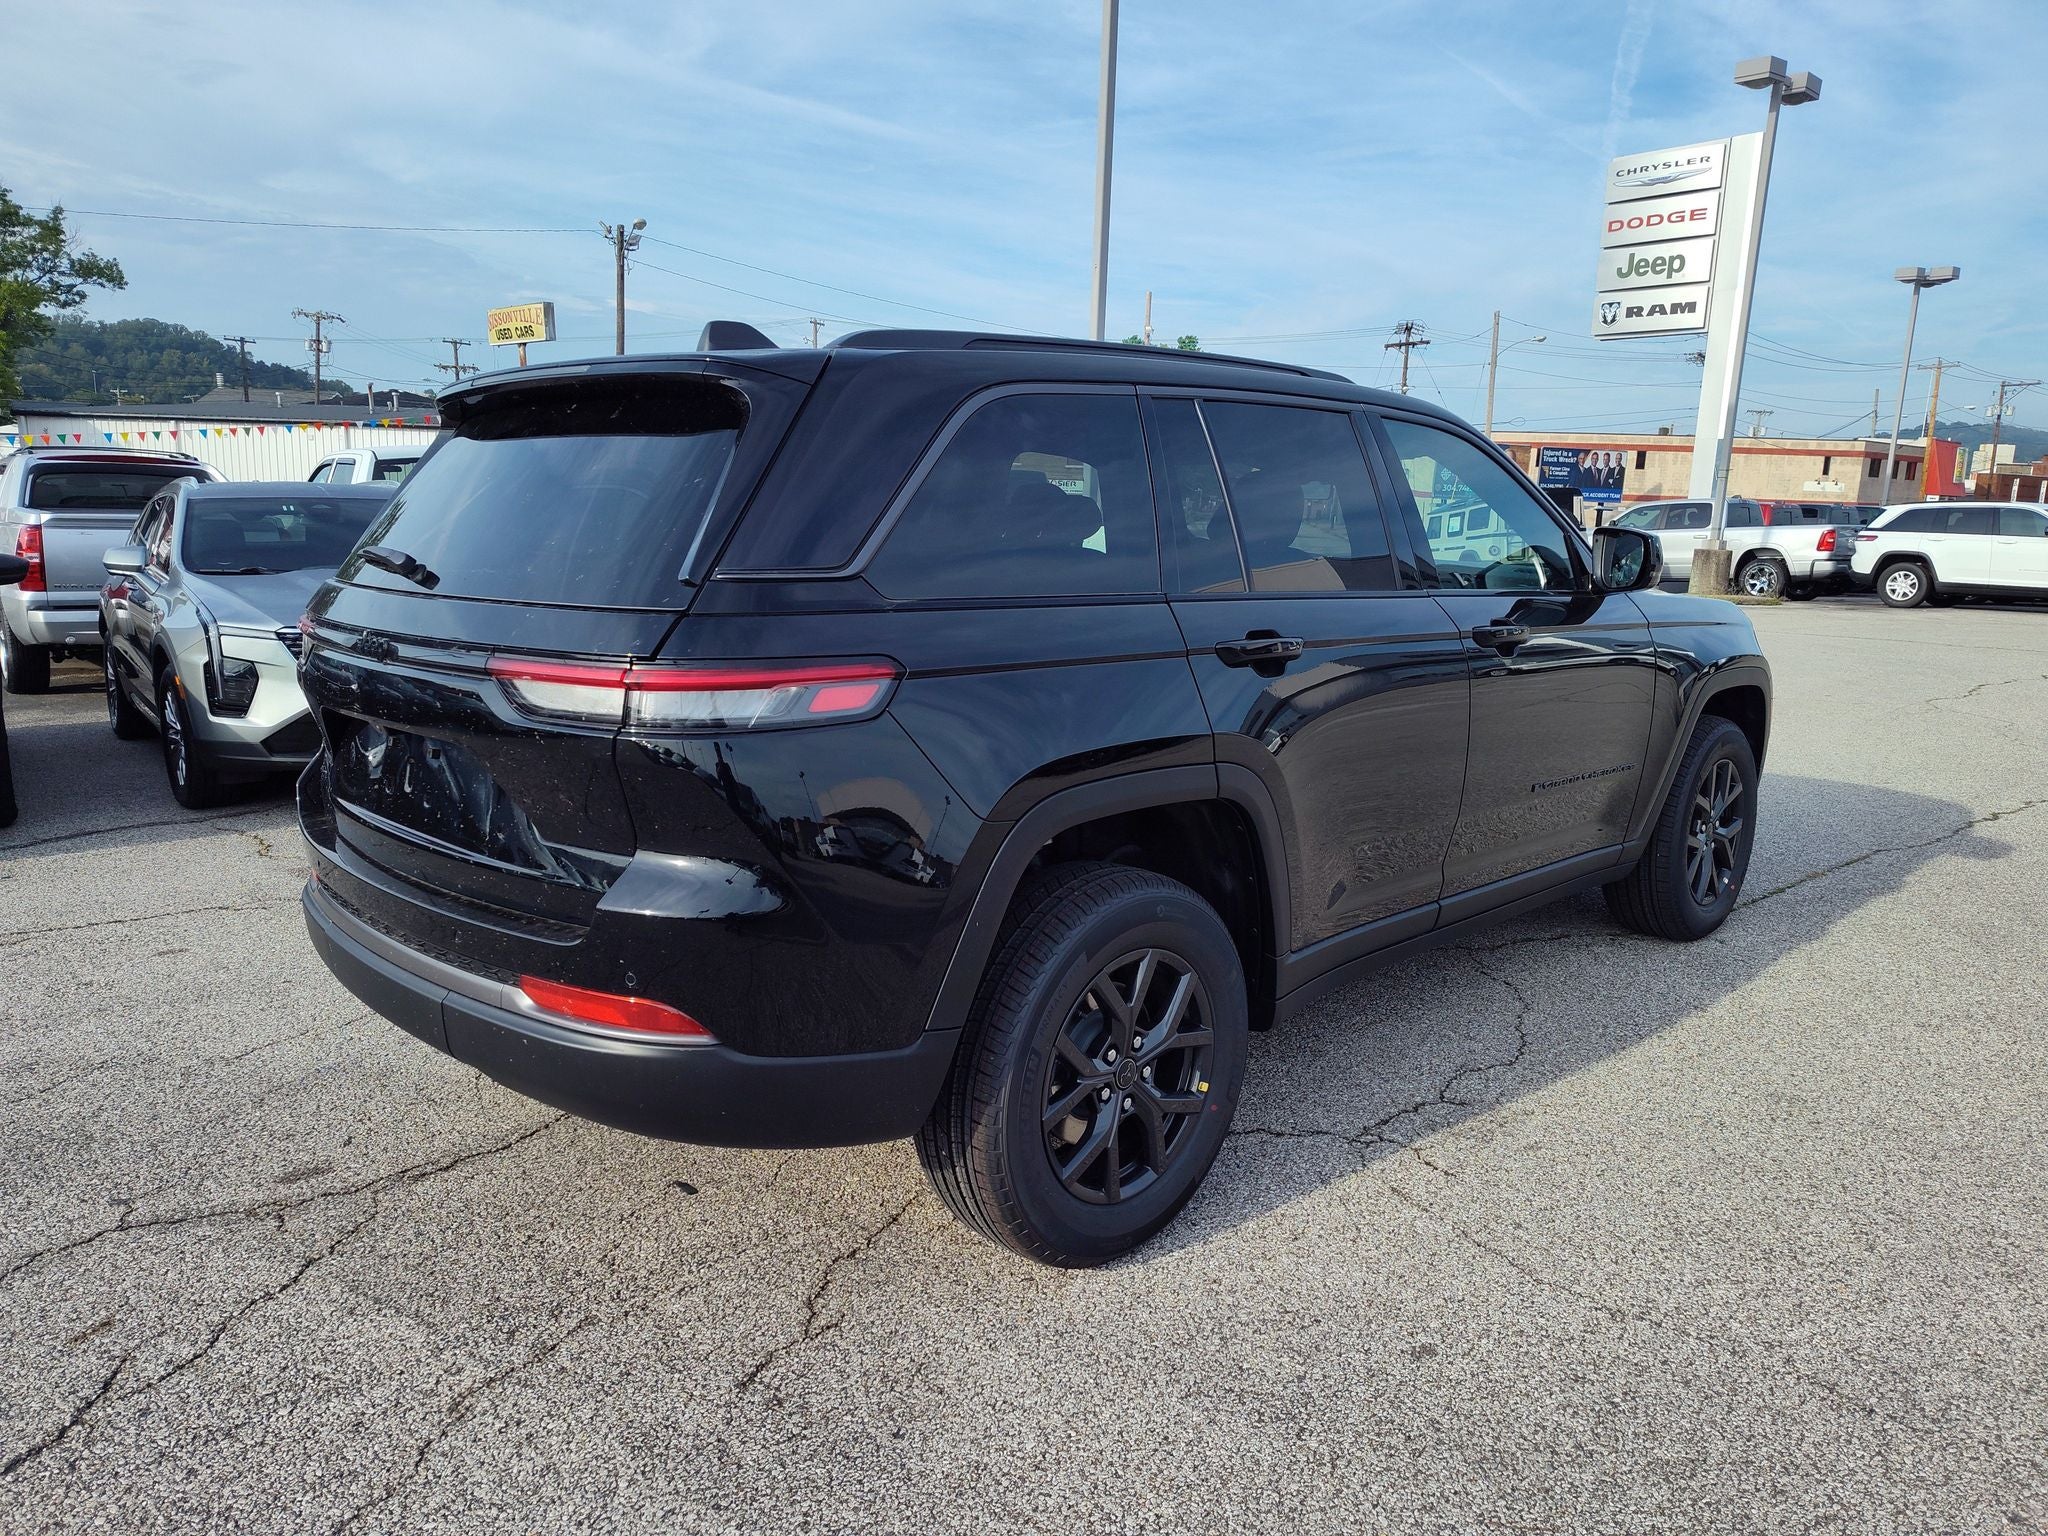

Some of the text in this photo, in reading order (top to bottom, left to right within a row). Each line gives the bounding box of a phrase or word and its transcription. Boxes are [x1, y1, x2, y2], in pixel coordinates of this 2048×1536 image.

[1616, 156, 1711, 177] CHRYSLER
[1607, 208, 1708, 233] DODGE
[1616, 252, 1686, 279] Jeep
[1625, 301, 1697, 319] RAM
[495, 324, 535, 341] USED CARS
[1543, 449, 1562, 457] Injured
